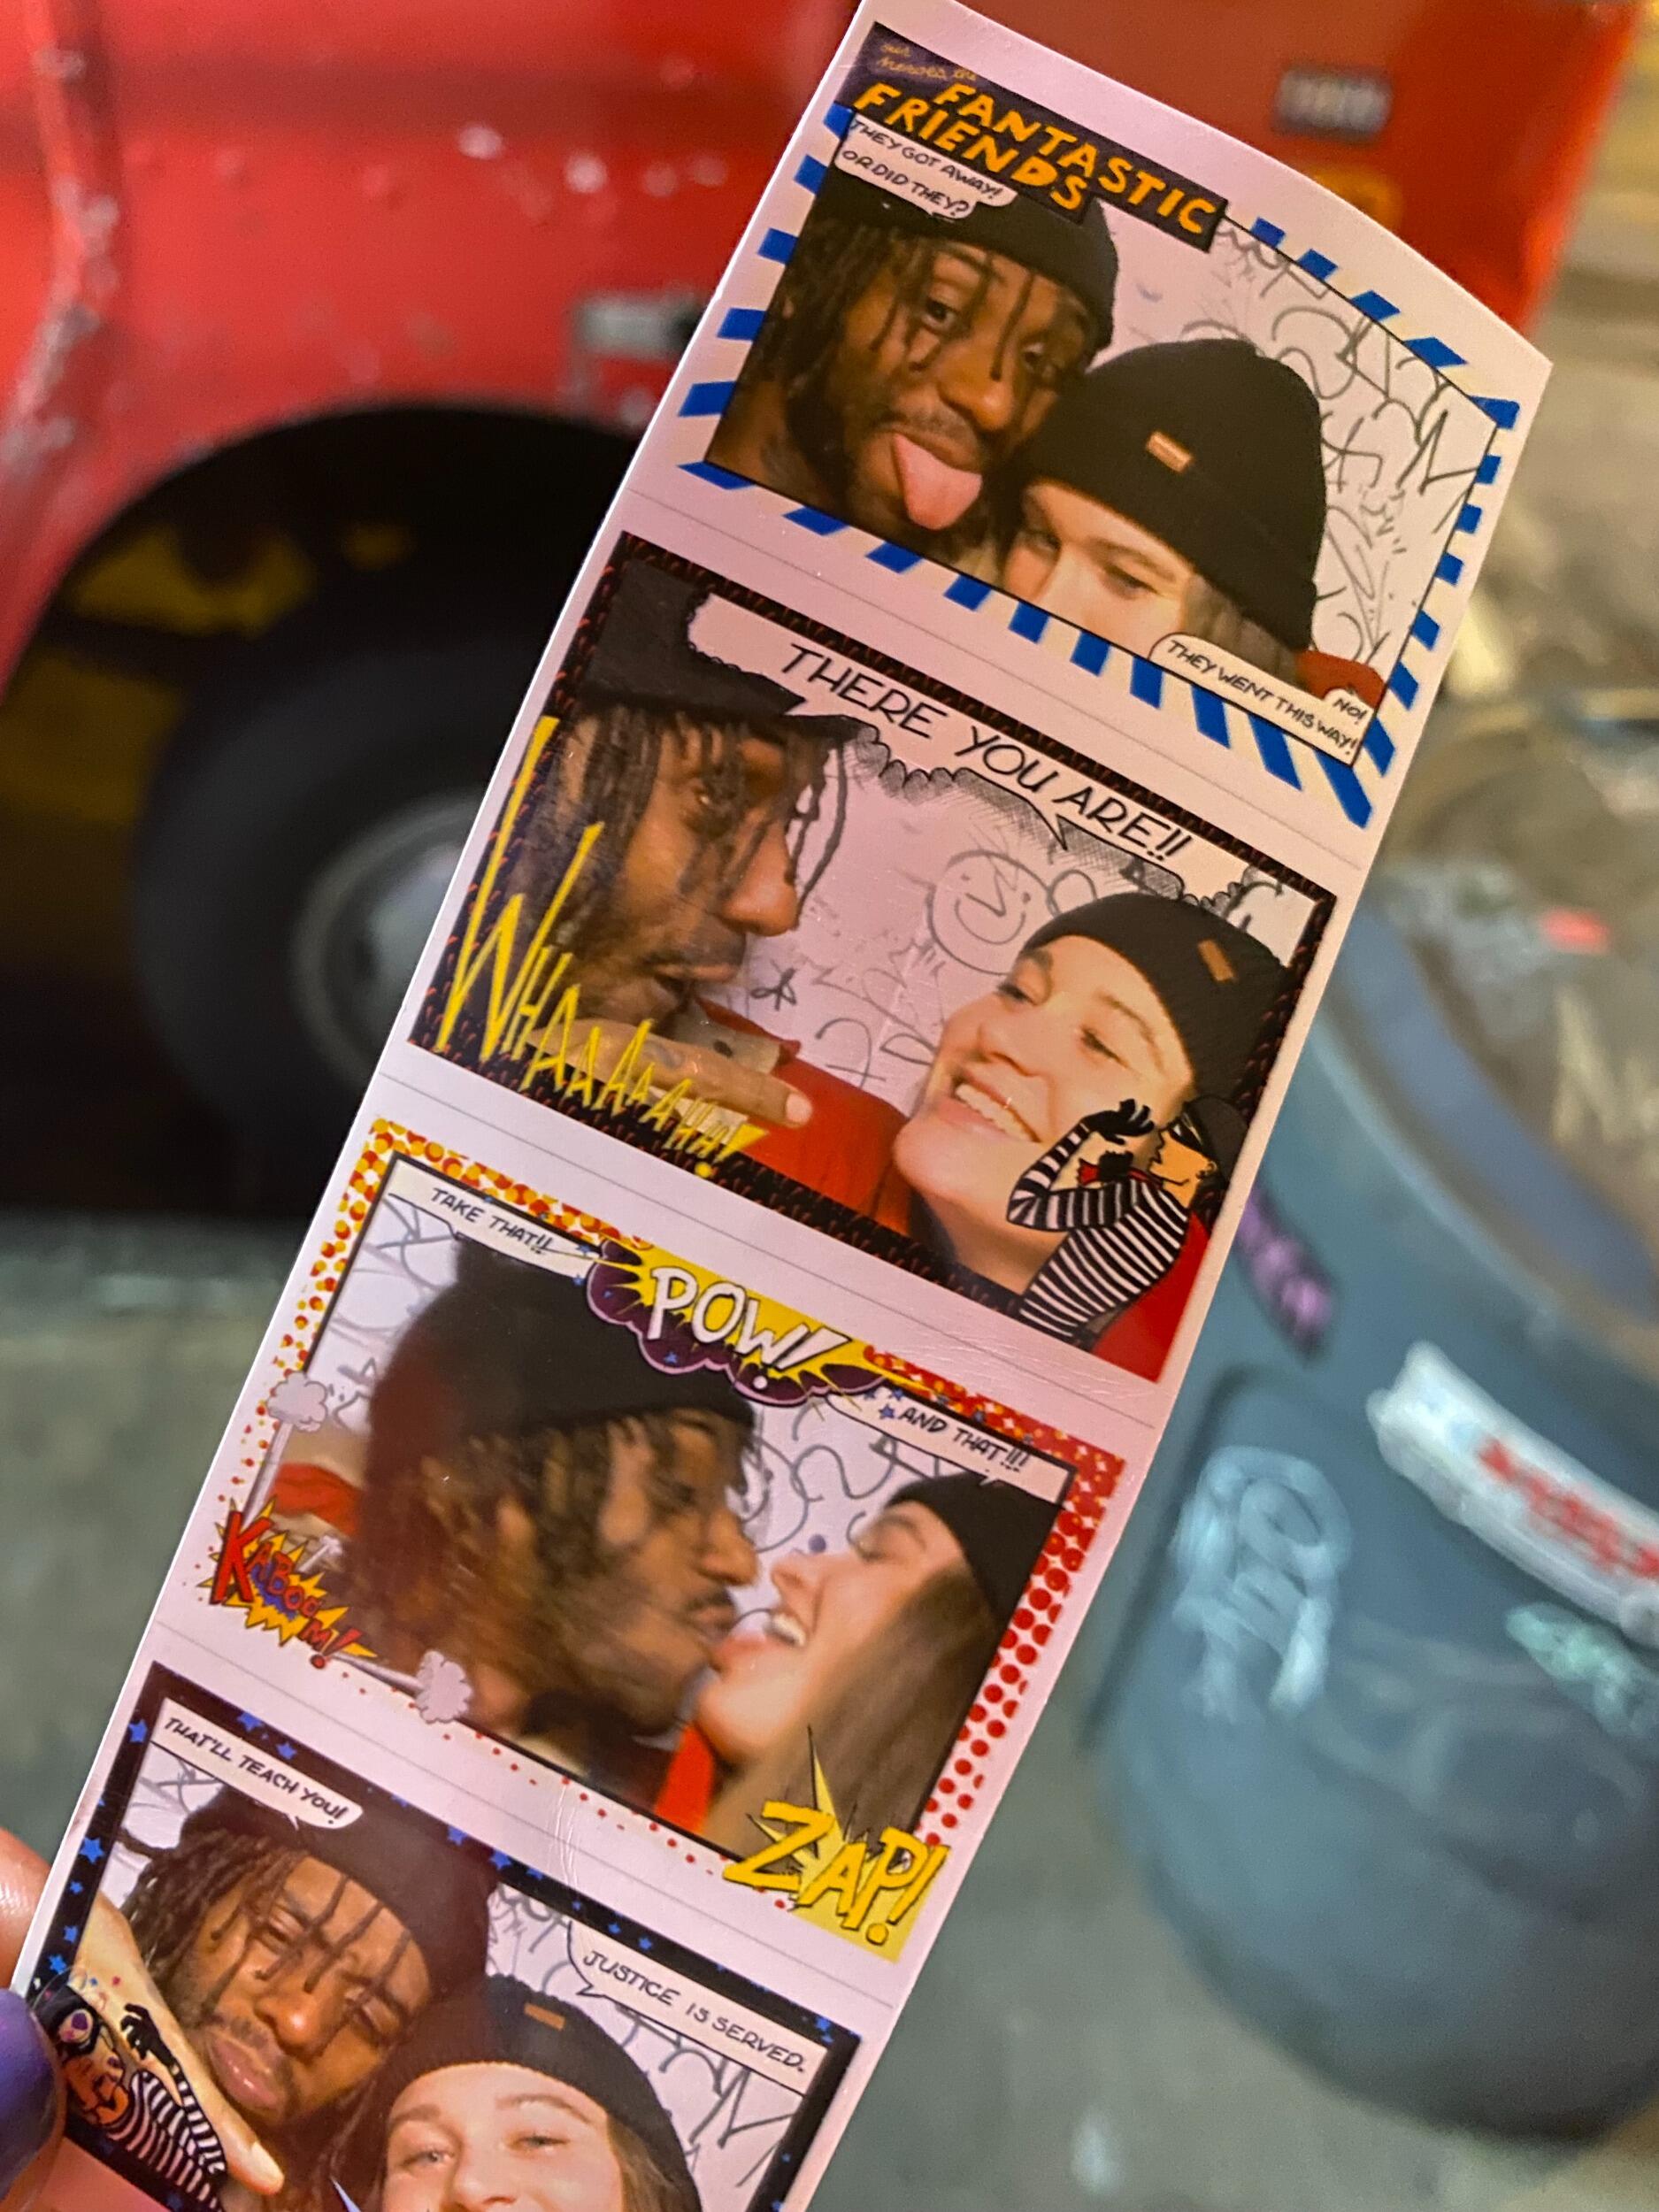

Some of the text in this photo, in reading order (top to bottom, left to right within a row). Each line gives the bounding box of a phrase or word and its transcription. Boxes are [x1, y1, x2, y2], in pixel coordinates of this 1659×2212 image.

[850, 120, 1003, 199] THEY GOT AWAY!
[852, 81, 1087, 211] FRIENDS
[871, 163, 909, 186] DID
[910, 180, 970, 217] THEY?
[933, 83, 1217, 236] FANTASTIC
[780, 642, 1193, 863] THERE YOU ARE!!
[1166, 639, 1359, 756] THEY WENT THIS WAY!
[1332, 697, 1368, 726] NO!
[431, 1187, 554, 1255] TAKE THAT!!
[646, 1264, 854, 1392] POW!
[898, 1407, 1032, 1474] AND THAT!!!
[164, 1717, 349, 1824] THAT'LL TEACH YOU!
[722, 1799, 951, 1947] ZAP!
[583, 1950, 806, 2073] JUSTICE IS SERVED.
